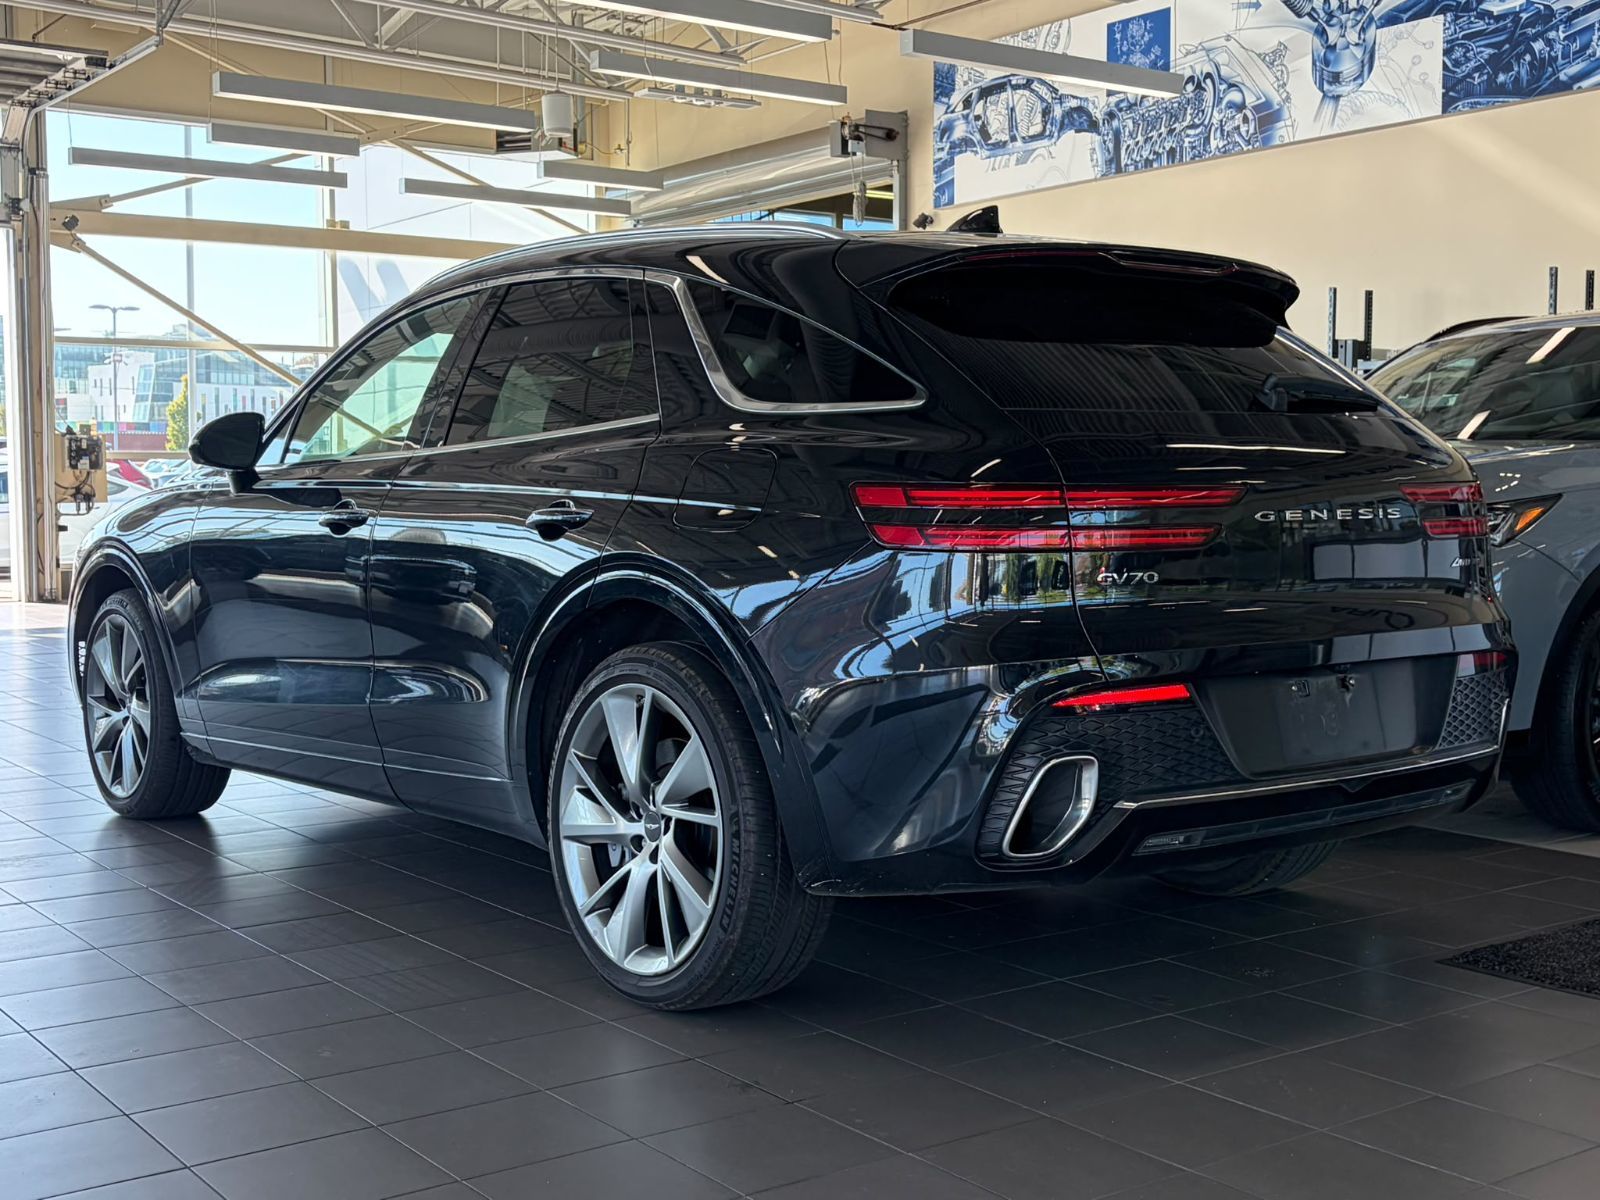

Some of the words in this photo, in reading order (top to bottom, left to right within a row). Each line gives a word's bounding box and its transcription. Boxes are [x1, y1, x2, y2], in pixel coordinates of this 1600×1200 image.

[1254, 507, 1401, 522] GENESIS
[1096, 571, 1159, 585] GV70
[721, 839, 740, 929] MICHELIN
